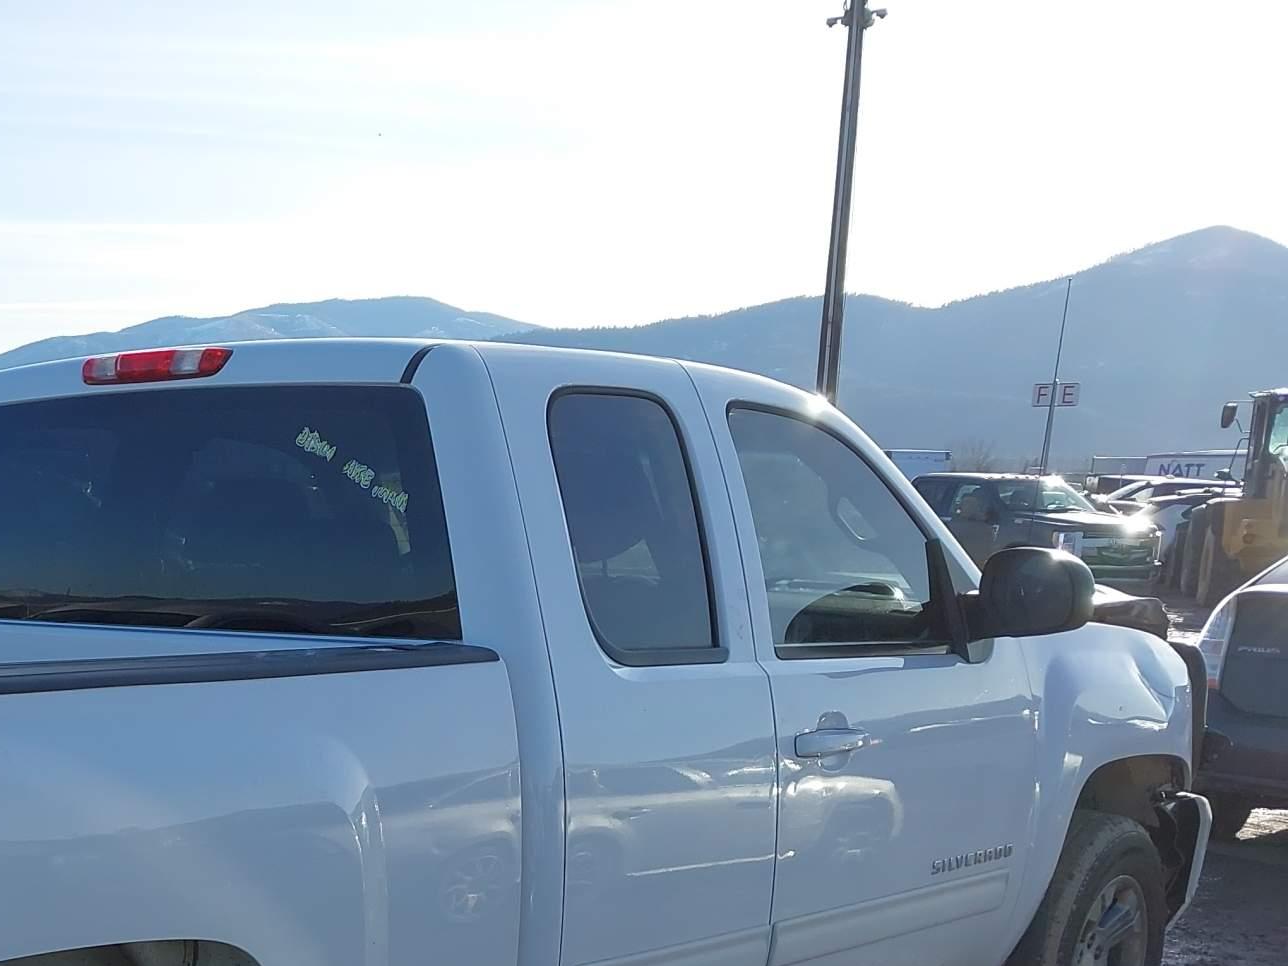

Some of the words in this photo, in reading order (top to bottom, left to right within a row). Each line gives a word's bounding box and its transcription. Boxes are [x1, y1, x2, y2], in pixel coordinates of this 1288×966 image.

[1037, 386, 1049, 404] F
[1062, 385, 1075, 404] E
[1158, 463, 1205, 478] NATT
[930, 843, 1014, 876] SILVERADO
